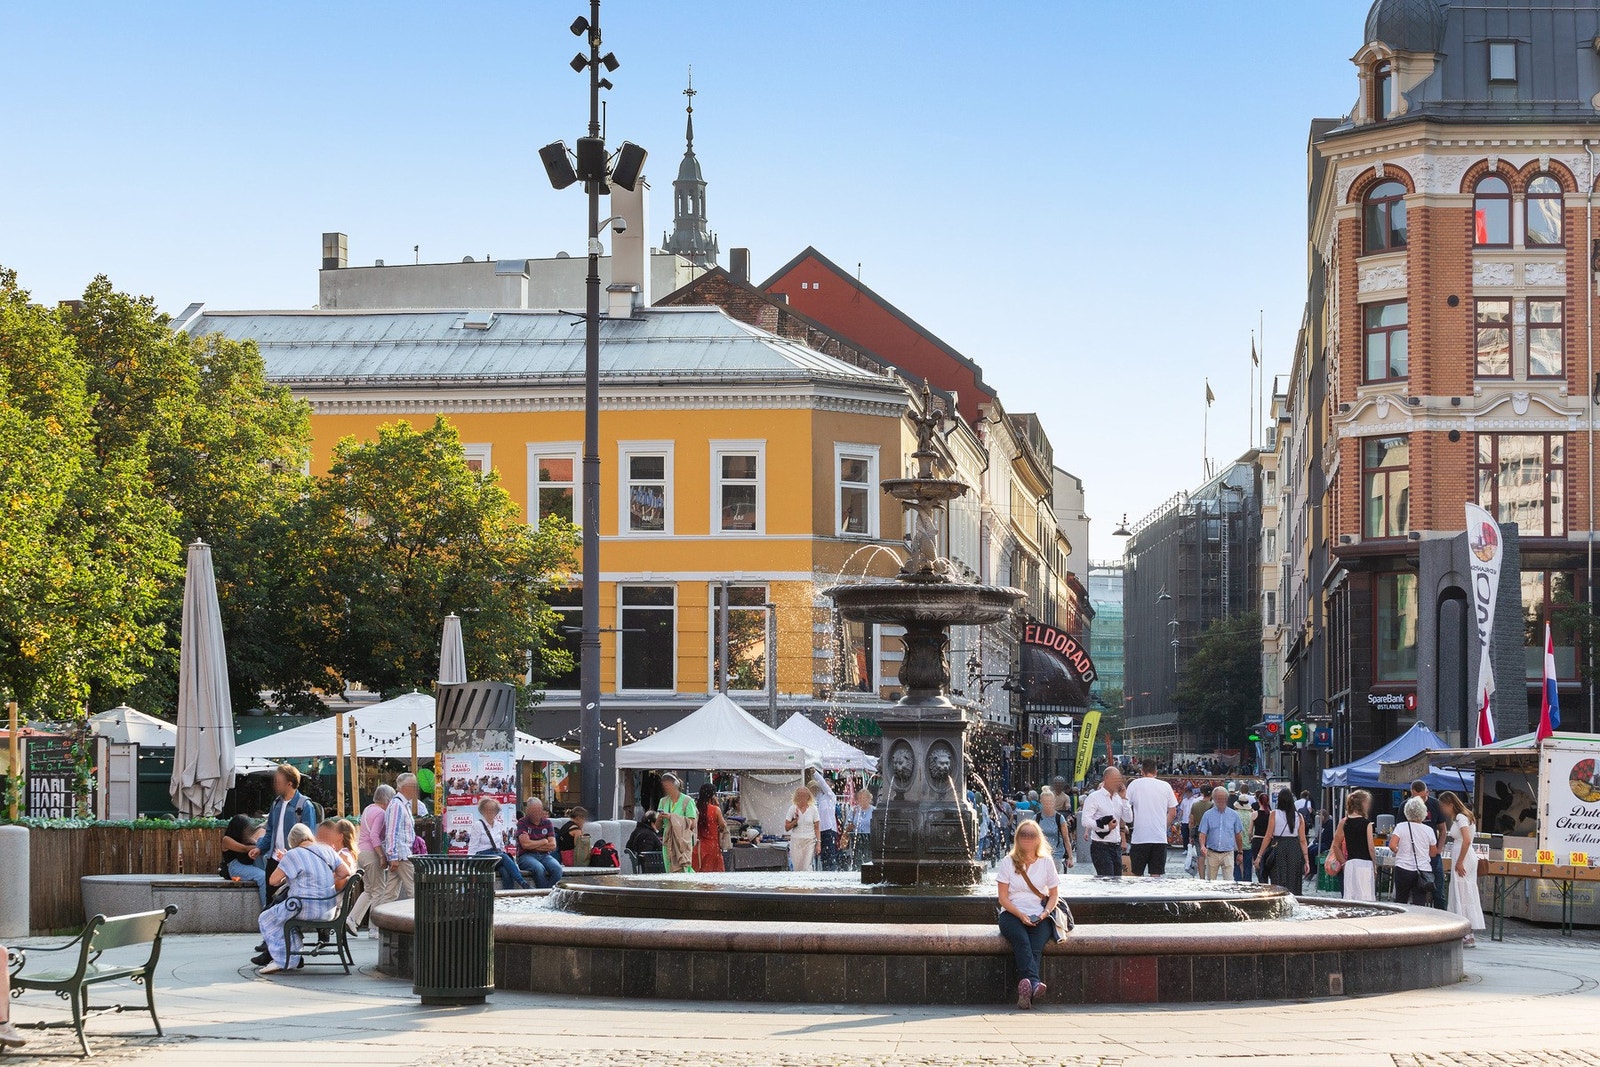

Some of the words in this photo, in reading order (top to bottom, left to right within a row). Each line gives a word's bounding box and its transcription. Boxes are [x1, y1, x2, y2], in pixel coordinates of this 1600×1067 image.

[1025, 624, 1094, 683] ELDORADO
[1367, 694, 1405, 704] SpareBank
[1076, 740, 1089, 775] stadium
